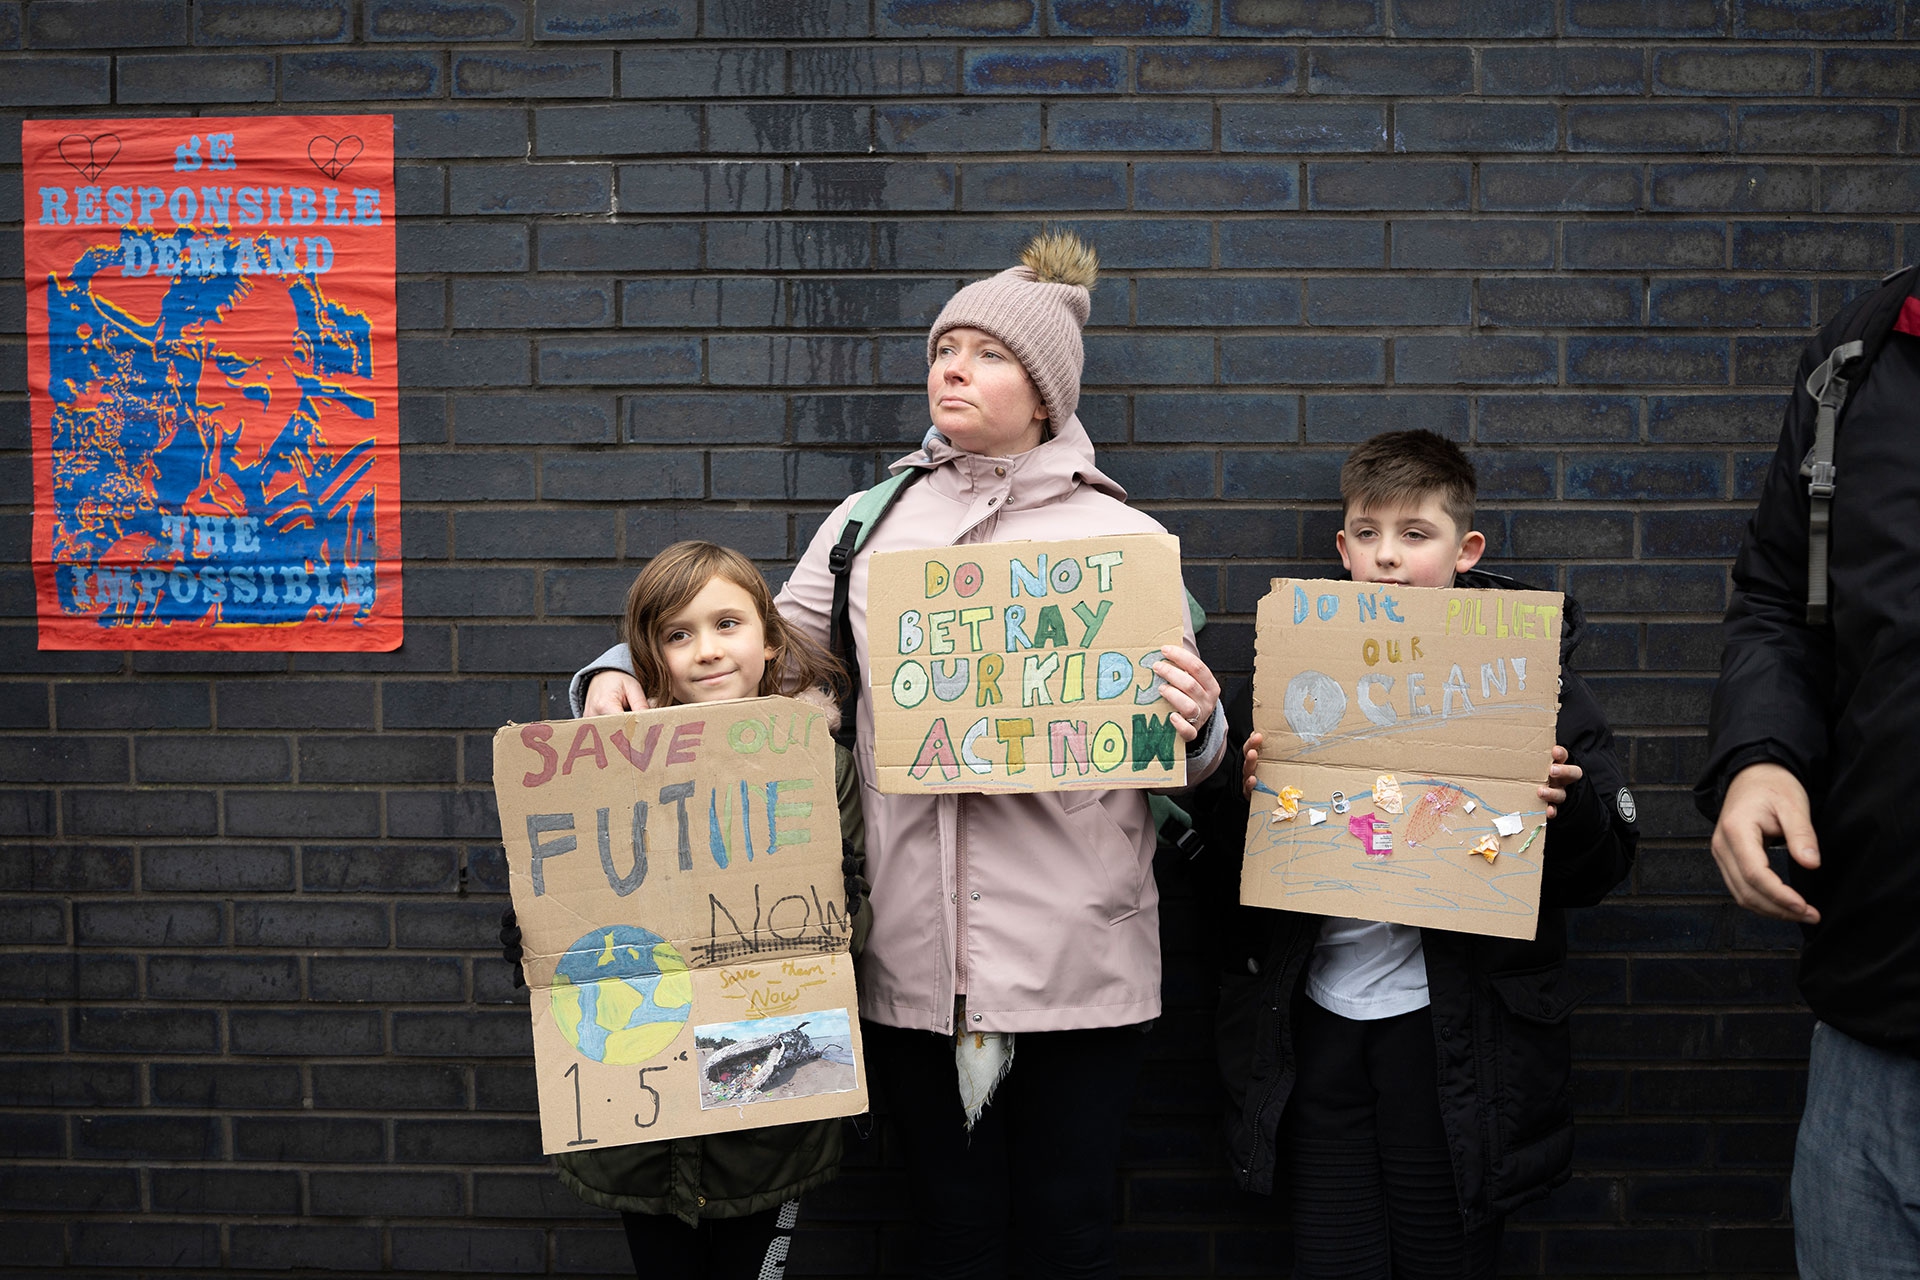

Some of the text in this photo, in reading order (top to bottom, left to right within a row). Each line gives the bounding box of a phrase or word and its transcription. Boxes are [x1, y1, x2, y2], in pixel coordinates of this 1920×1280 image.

[174, 133, 237, 171] BE
[38, 185, 383, 226] RESPONSIBLE
[120, 236, 335, 278] DEMAND
[161, 515, 261, 554] THE
[71, 565, 376, 604] IMPOSSIBLE
[924, 551, 1123, 599] DO NOT
[898, 600, 1114, 655] BETRAY
[892, 651, 1172, 710] OUR KIDS
[1283, 656, 1528, 746] OCEAN!
[520, 720, 706, 788] SAVE
[908, 712, 1178, 781] ACT NOW
[708, 884, 850, 963] NOW
[719, 969, 761, 990] Save
